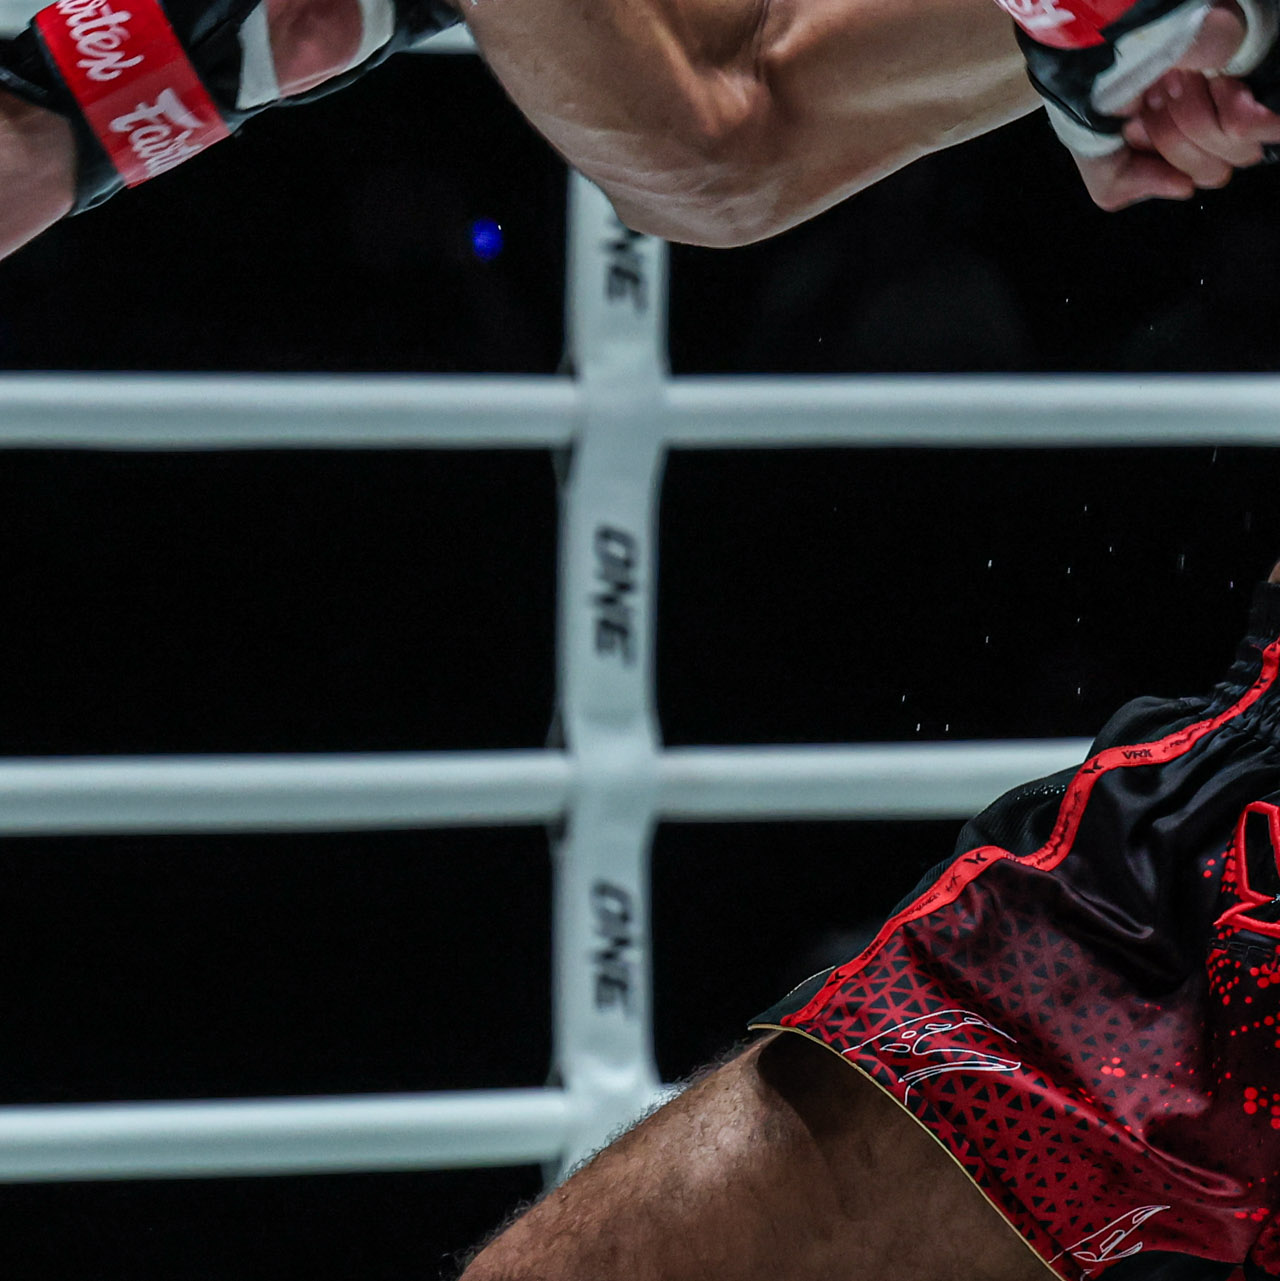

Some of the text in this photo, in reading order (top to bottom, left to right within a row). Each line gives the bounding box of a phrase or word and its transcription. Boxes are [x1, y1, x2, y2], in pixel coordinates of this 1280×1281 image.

[600, 217, 650, 314] NE
[590, 524, 638, 669] ONE
[590, 879, 634, 1017] ONE
